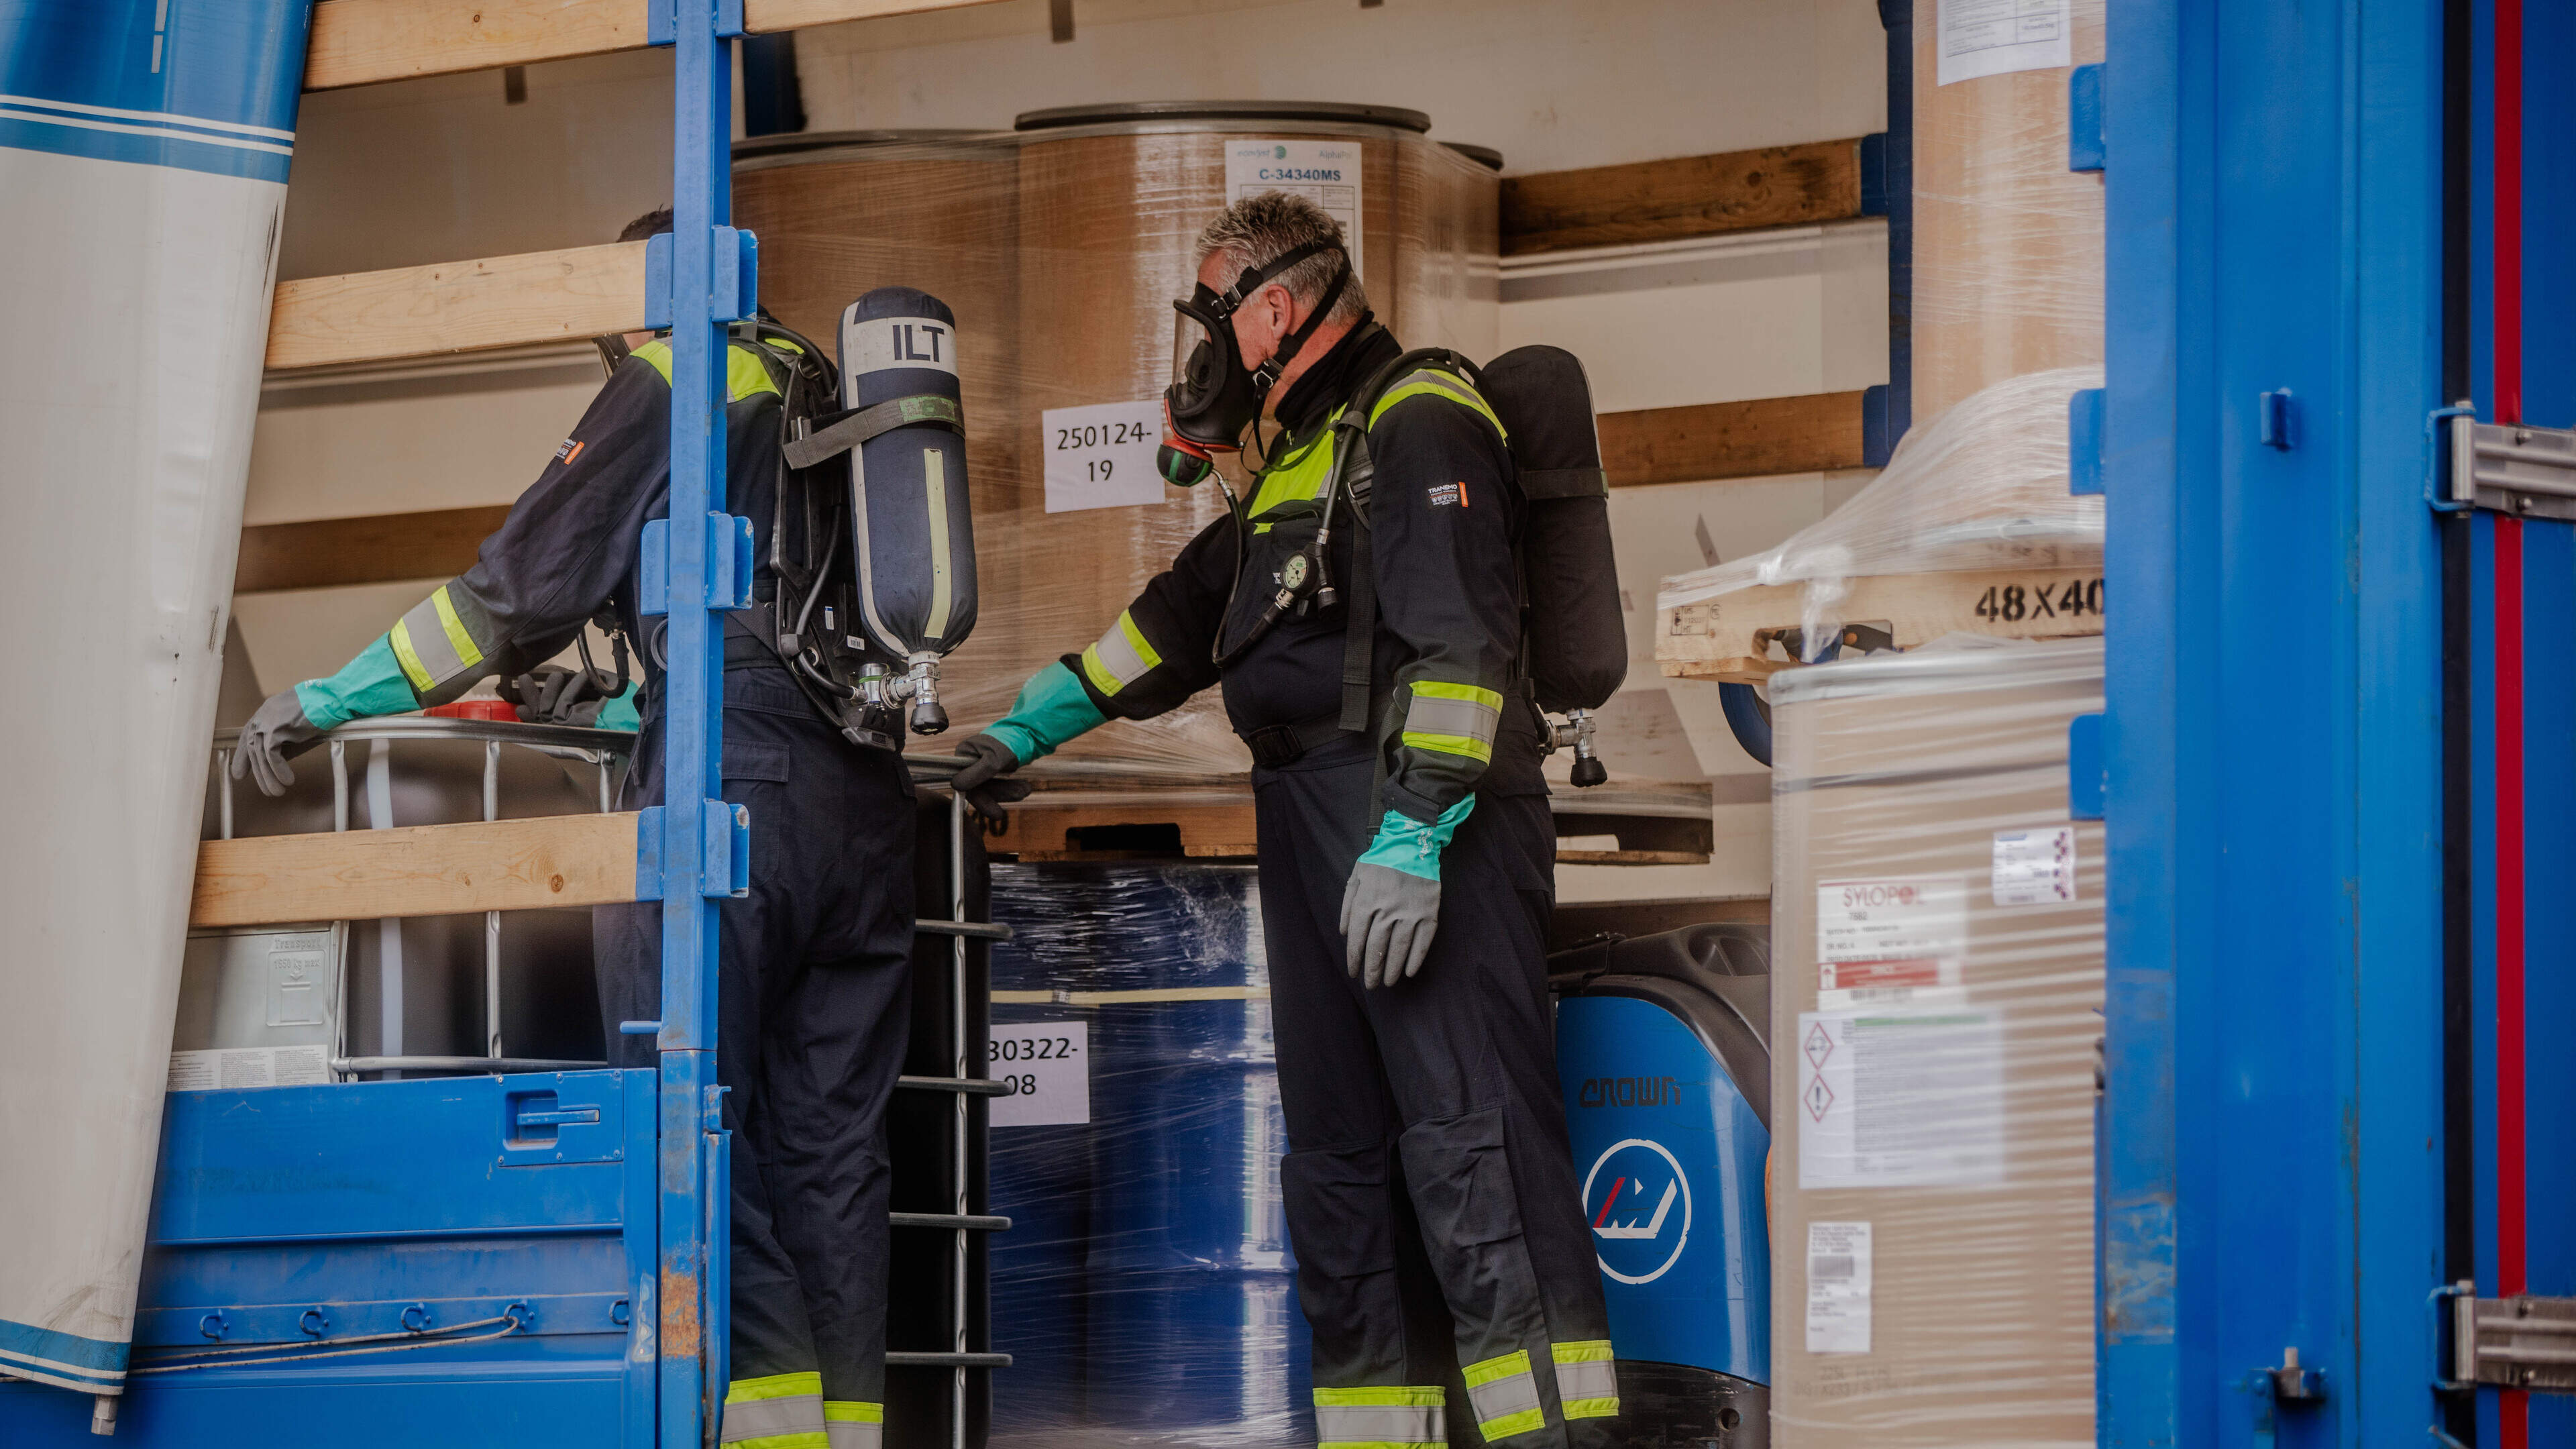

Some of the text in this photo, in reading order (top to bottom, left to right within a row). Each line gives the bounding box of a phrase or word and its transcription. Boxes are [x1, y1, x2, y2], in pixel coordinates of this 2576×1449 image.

[1259, 168, 1341, 181] C-34340MS
[892, 324, 945, 363] ILT
[1057, 422, 1152, 450] 250124-
[1088, 460, 1114, 482] 19
[1428, 484, 1458, 494] TRANEMO
[1843, 885, 1927, 908] SYLOPOL
[274, 937, 322, 950] Transport
[1004, 1074, 1036, 1096] 08
[1579, 1076, 1681, 1108] CROWN
